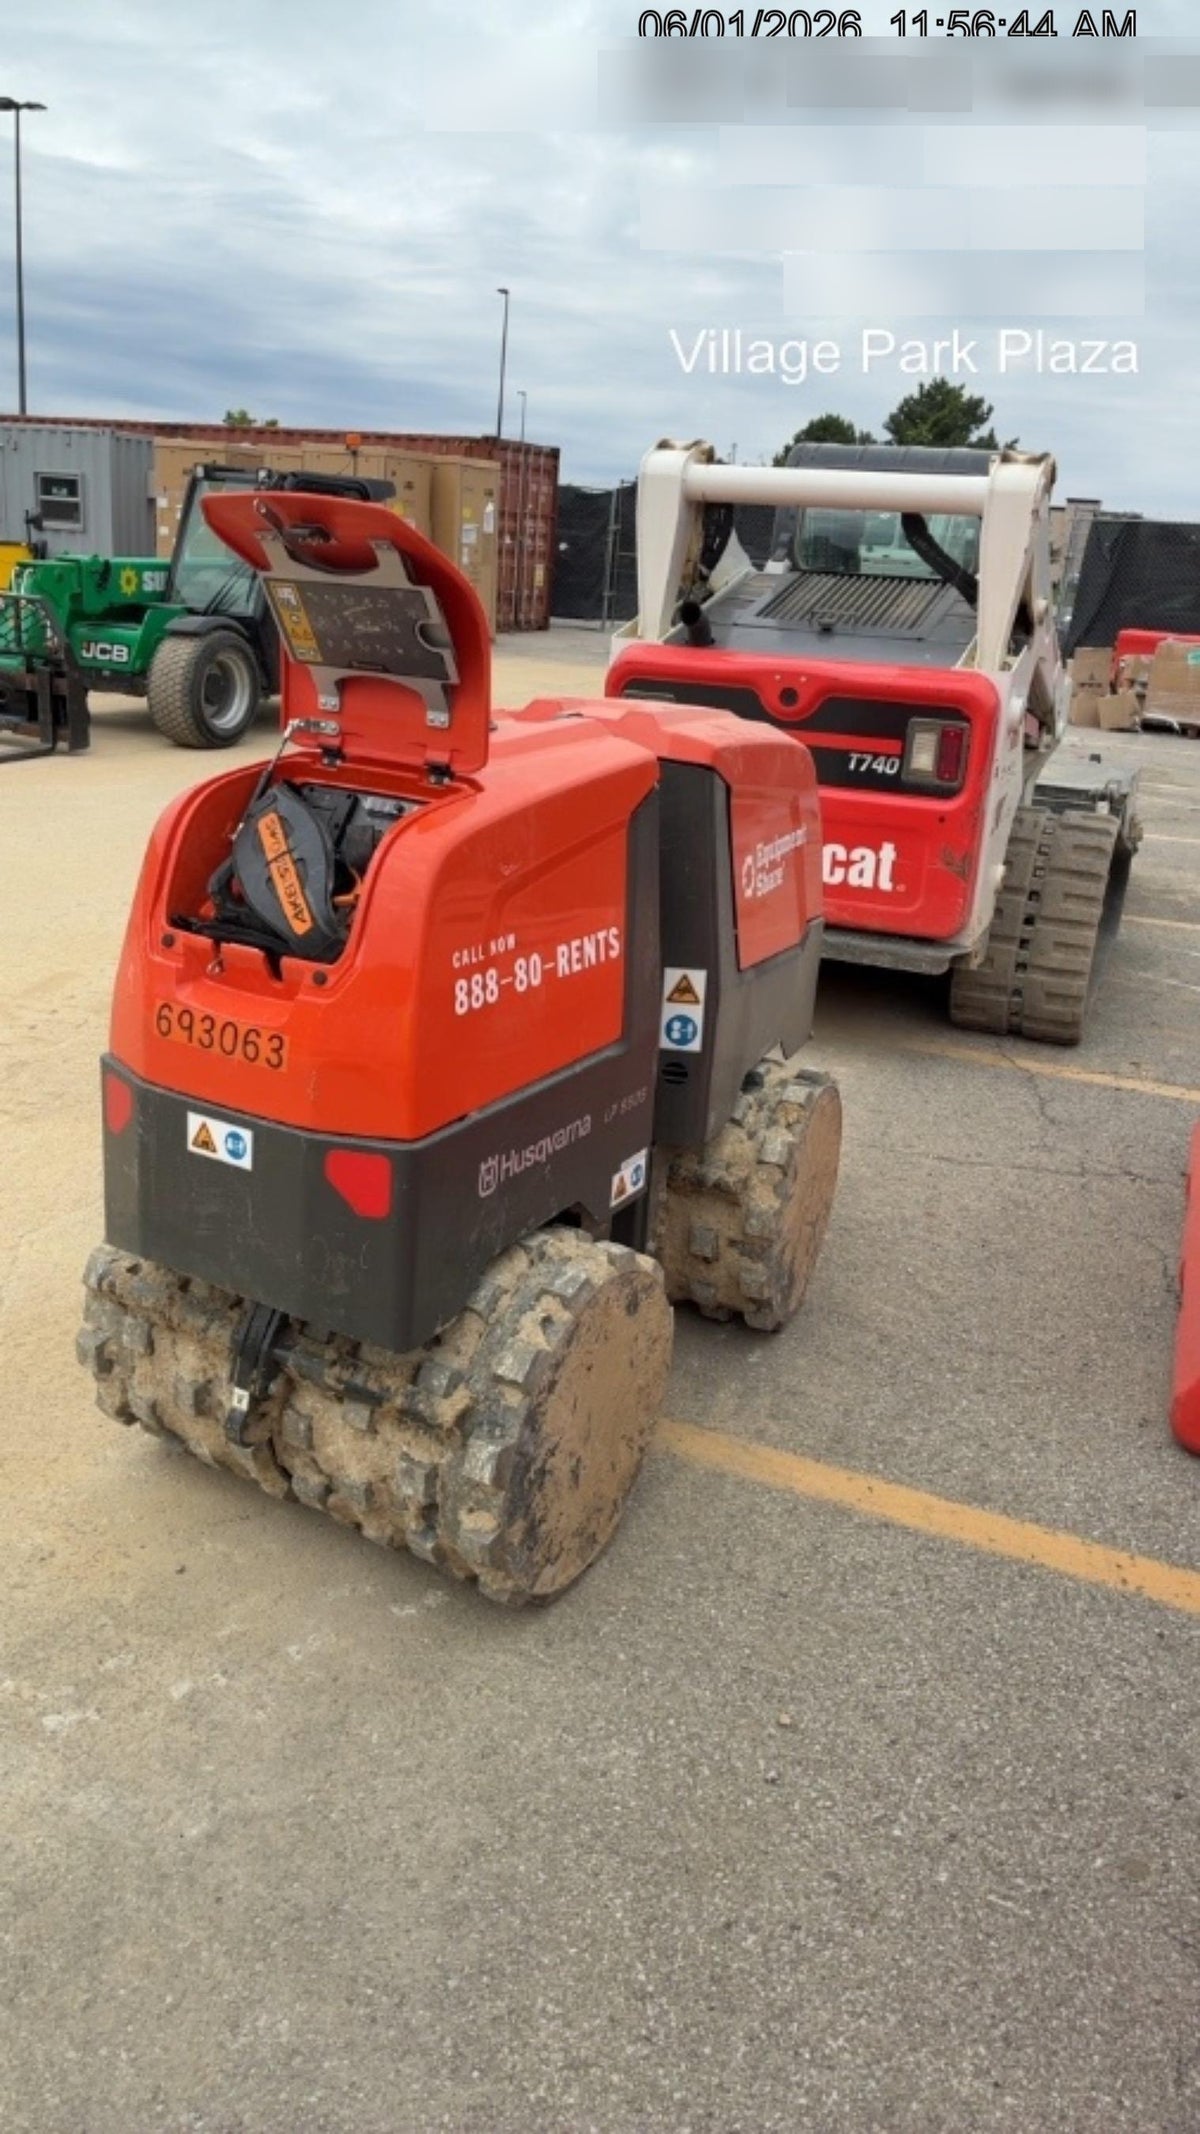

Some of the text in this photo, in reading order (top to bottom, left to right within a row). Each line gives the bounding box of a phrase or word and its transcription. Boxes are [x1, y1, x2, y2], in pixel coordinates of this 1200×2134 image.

[81, 642, 130, 663] JCB
[847, 752, 900, 774] T740
[452, 933, 516, 969] CALL NOW
[454, 926, 620, 1016] 888-80-RENTS
[156, 1002, 285, 1070] 693063
[500, 1113, 592, 1182] Husqvarna
